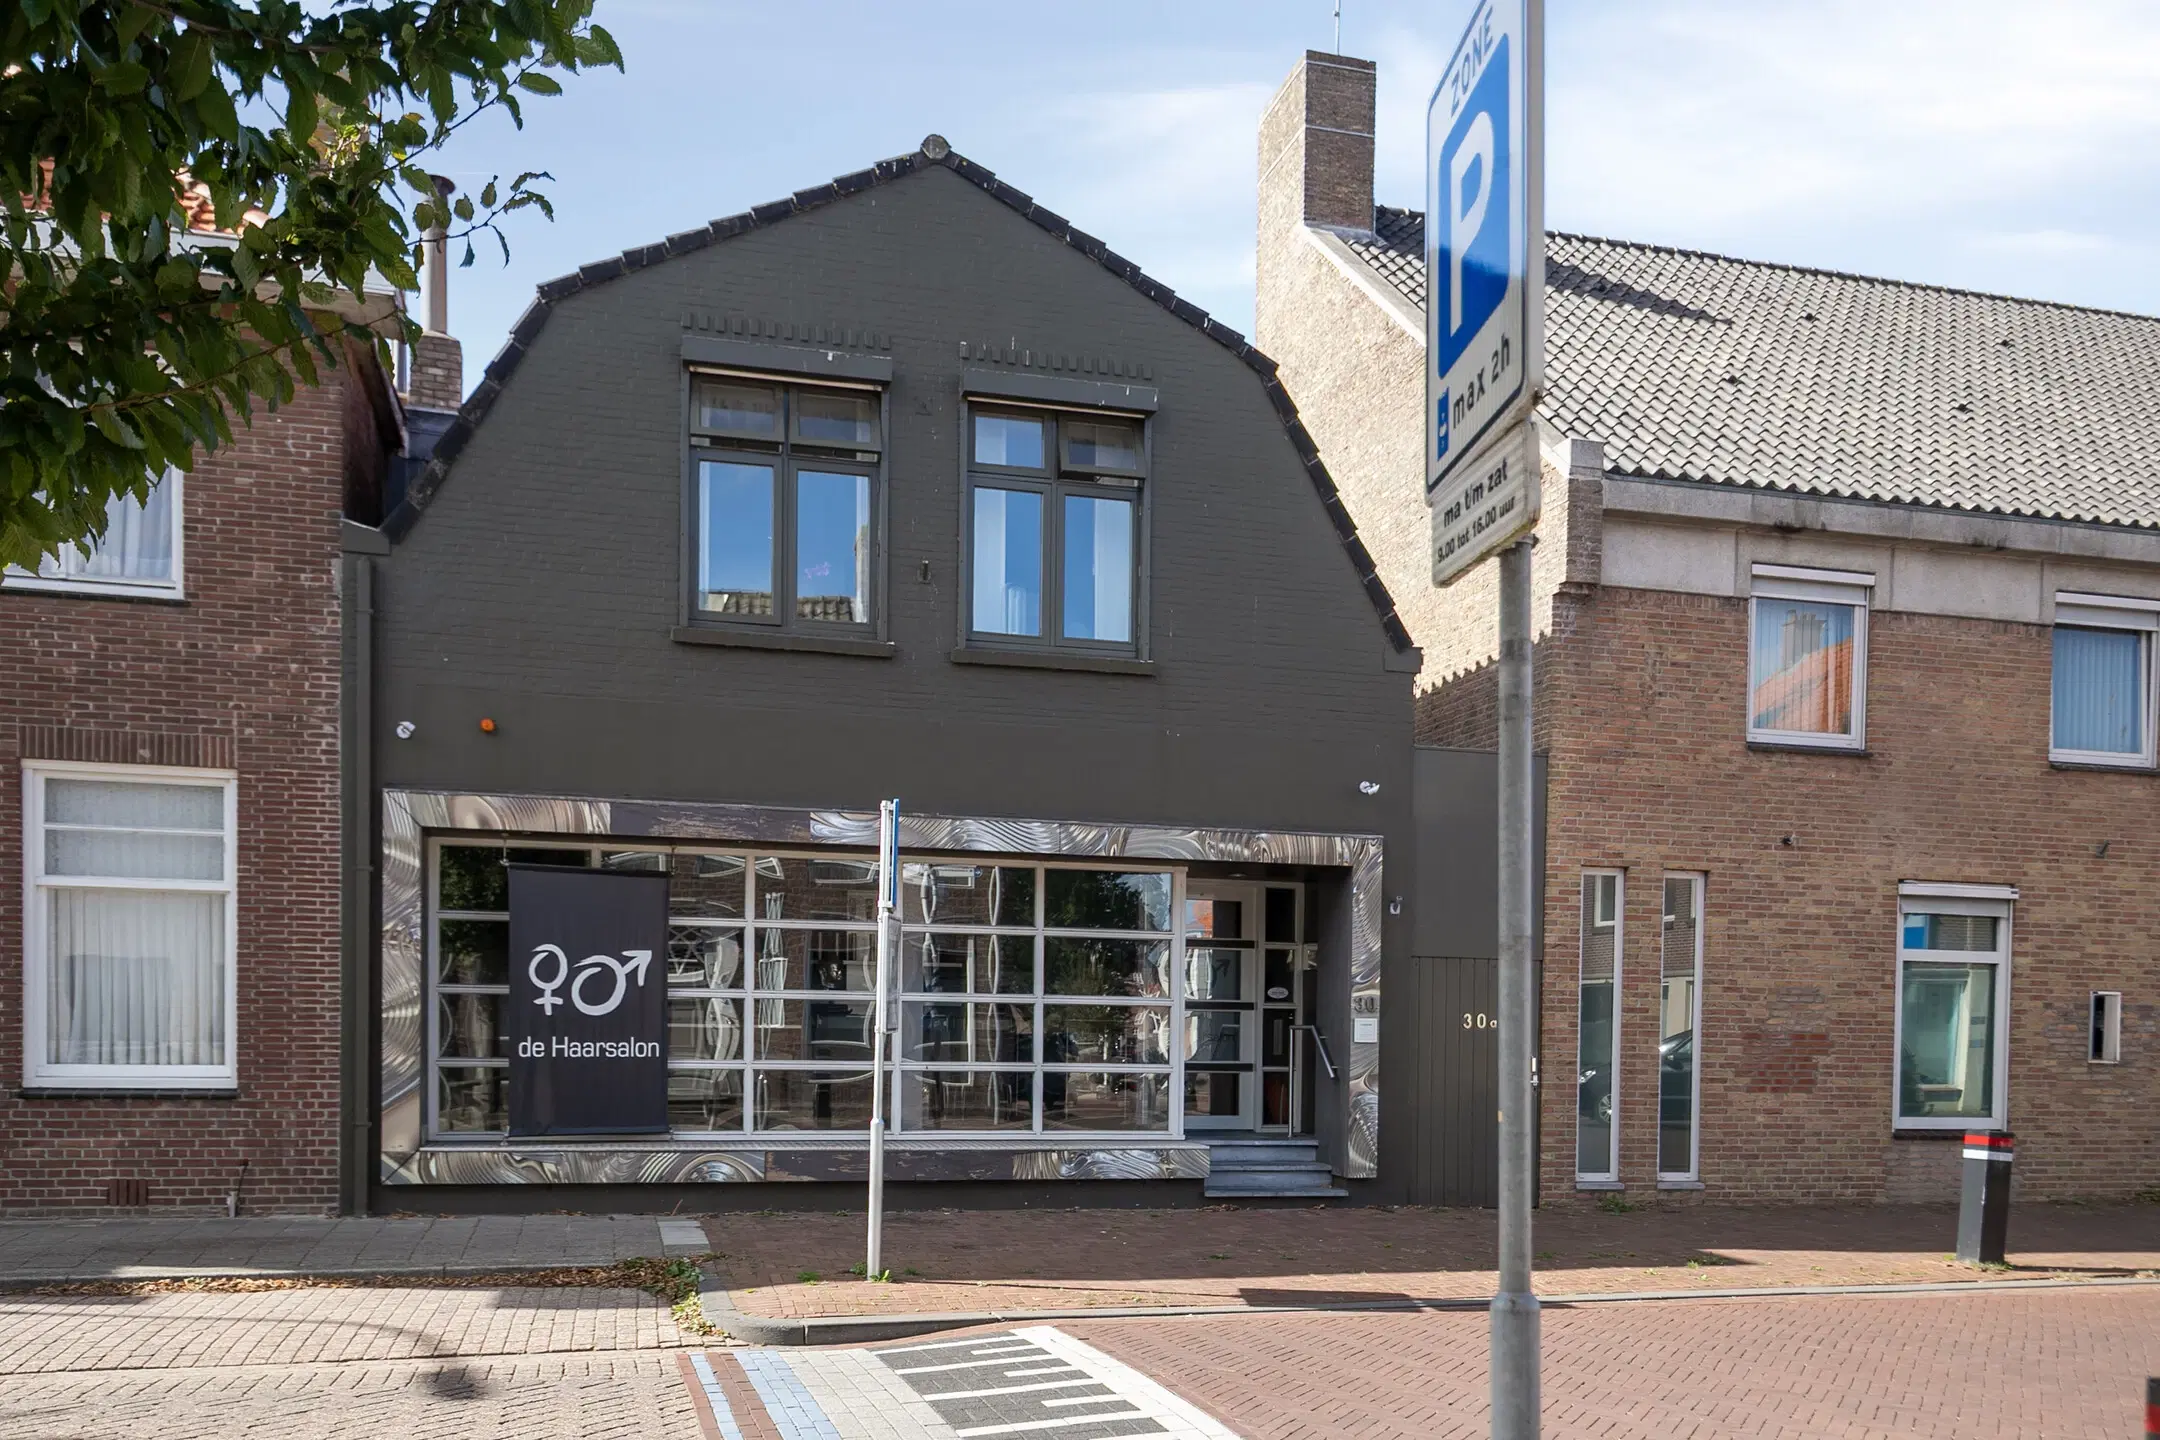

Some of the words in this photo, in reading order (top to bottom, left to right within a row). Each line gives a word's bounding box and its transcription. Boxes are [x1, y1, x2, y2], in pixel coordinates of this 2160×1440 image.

[1451, 5, 1493, 117] ZONE
[1451, 111, 1494, 338] P
[1453, 366, 1485, 429] max
[1492, 332, 1510, 384] 2h
[1444, 501, 1461, 528] ma
[1465, 483, 1483, 511] t/m
[1488, 457, 1508, 493] zat
[1438, 537, 1455, 563] 9.00
[1458, 528, 1470, 549] tot
[1473, 506, 1497, 537] 16.00
[1500, 496, 1515, 518] uur
[1354, 997, 1375, 1013] 30
[518, 1036, 545, 1057] de
[553, 1036, 660, 1057] Haarsalon
